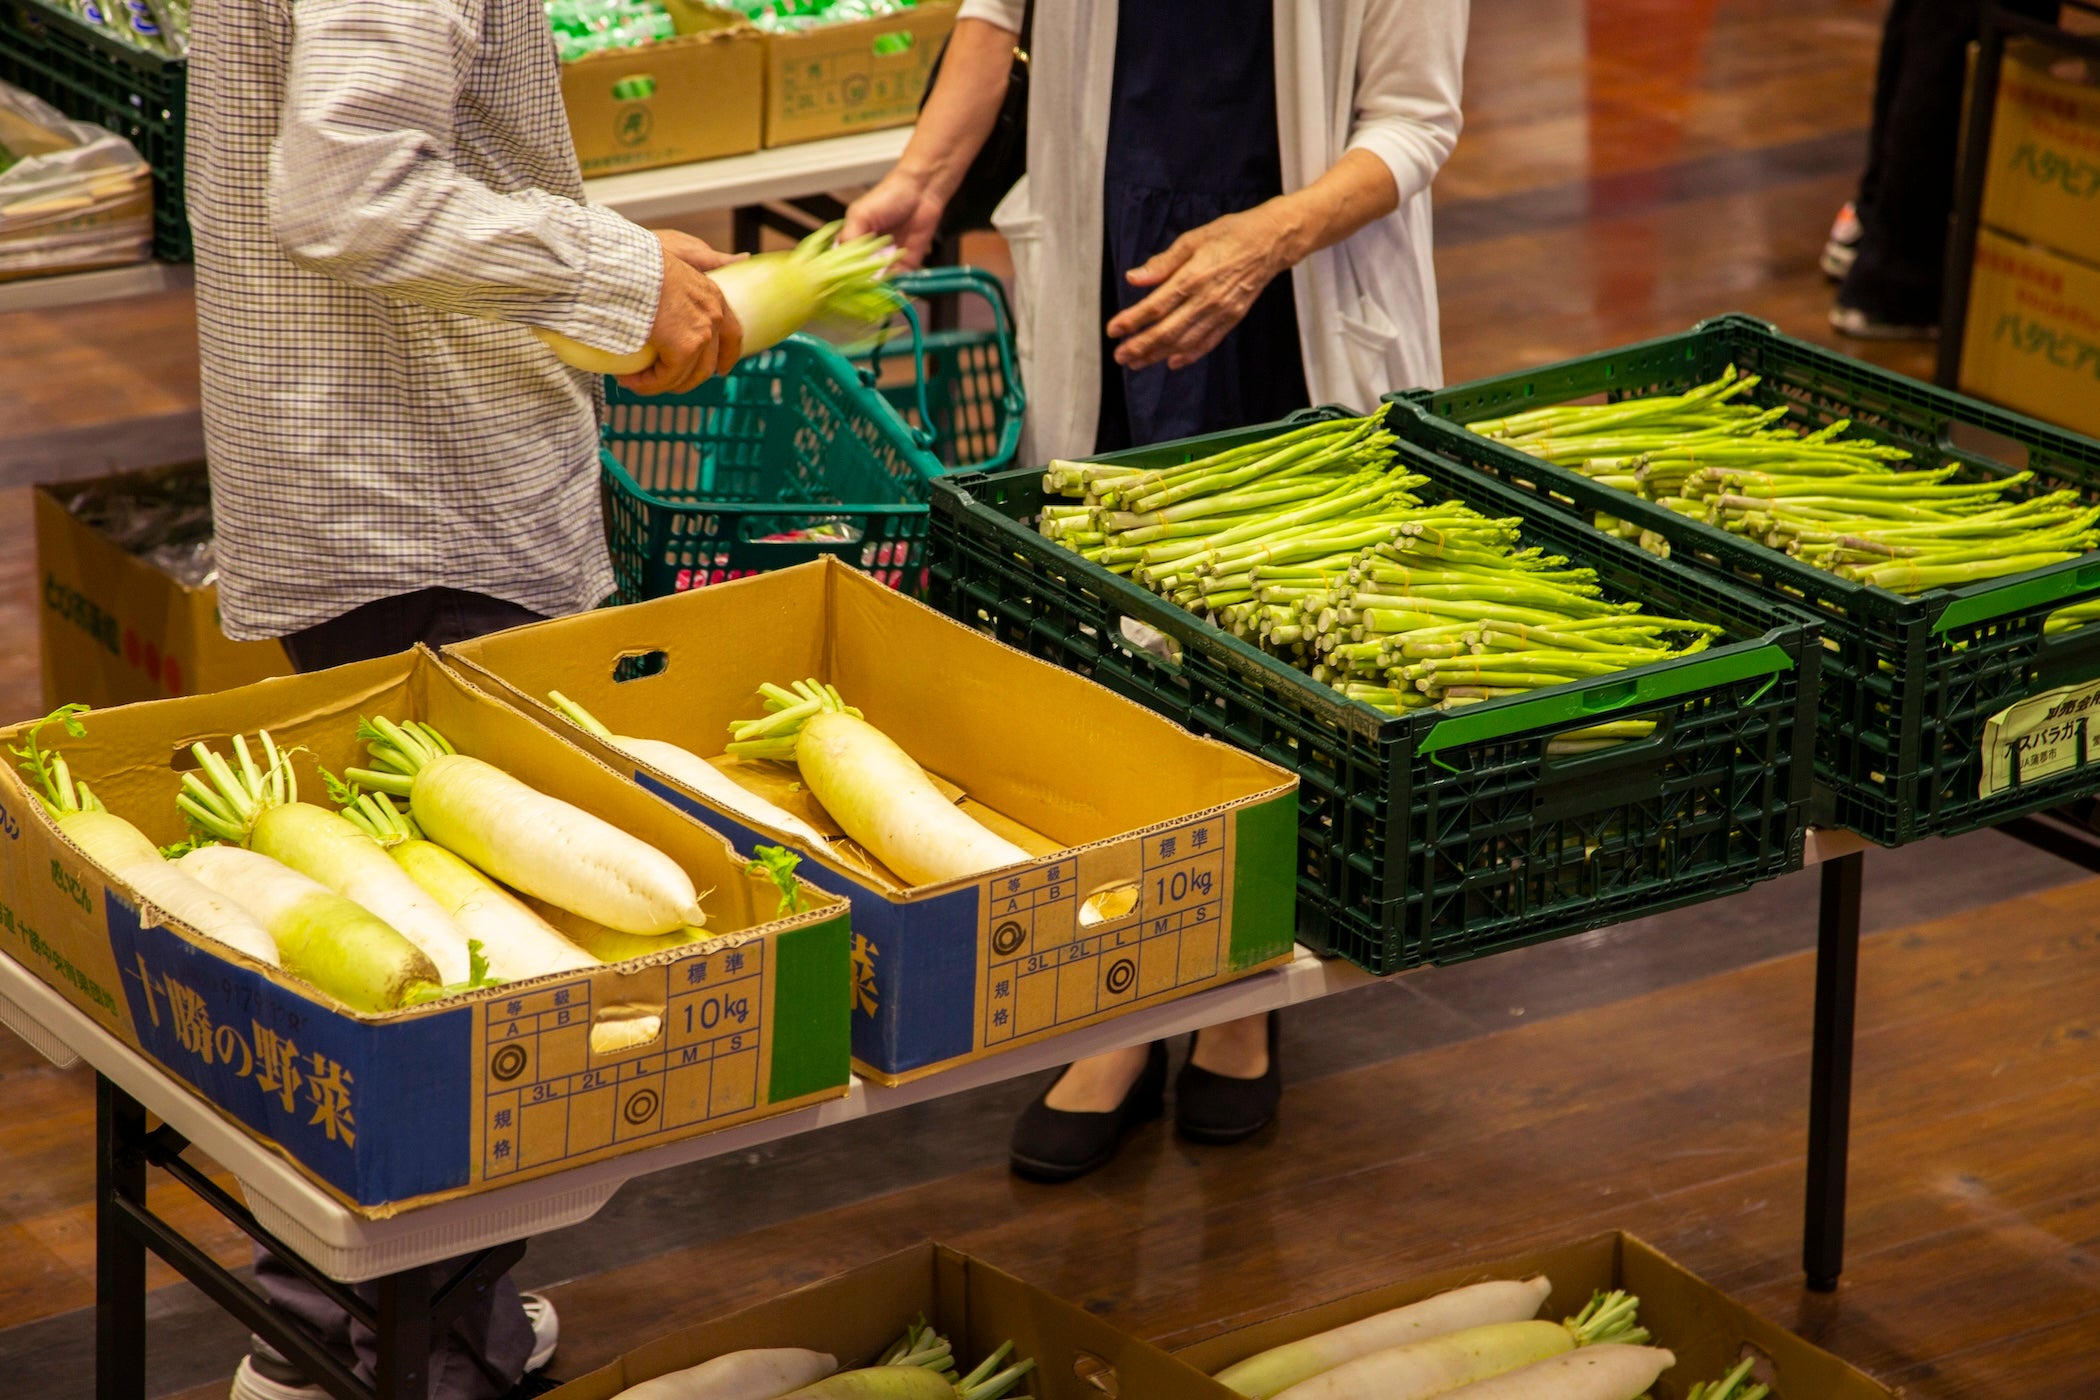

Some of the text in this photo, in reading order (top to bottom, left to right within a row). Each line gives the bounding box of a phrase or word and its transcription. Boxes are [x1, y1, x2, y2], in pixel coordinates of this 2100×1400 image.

[1160, 828, 1208, 859] 標準
[1049, 885, 1061, 899] B
[1156, 866, 1212, 906] 10kg
[1007, 897, 1019, 912] A
[1195, 906, 1207, 922] S
[1154, 919, 1169, 934] M
[1115, 931, 1126, 946] L
[1069, 943, 1091, 960] 2L
[688, 952, 745, 986] 標準
[1027, 956, 1049, 972] 3L
[557, 1010, 571, 1026] B
[682, 993, 750, 1035] 10kg
[506, 1022, 520, 1038] A
[124, 952, 357, 1150] 十勝の野菜
[730, 1035, 743, 1051] S
[682, 1047, 698, 1064] M
[636, 1060, 648, 1076] L
[582, 1072, 607, 1090] 2L
[532, 1084, 558, 1102] 3L
[493, 1108, 512, 1160] 規格
